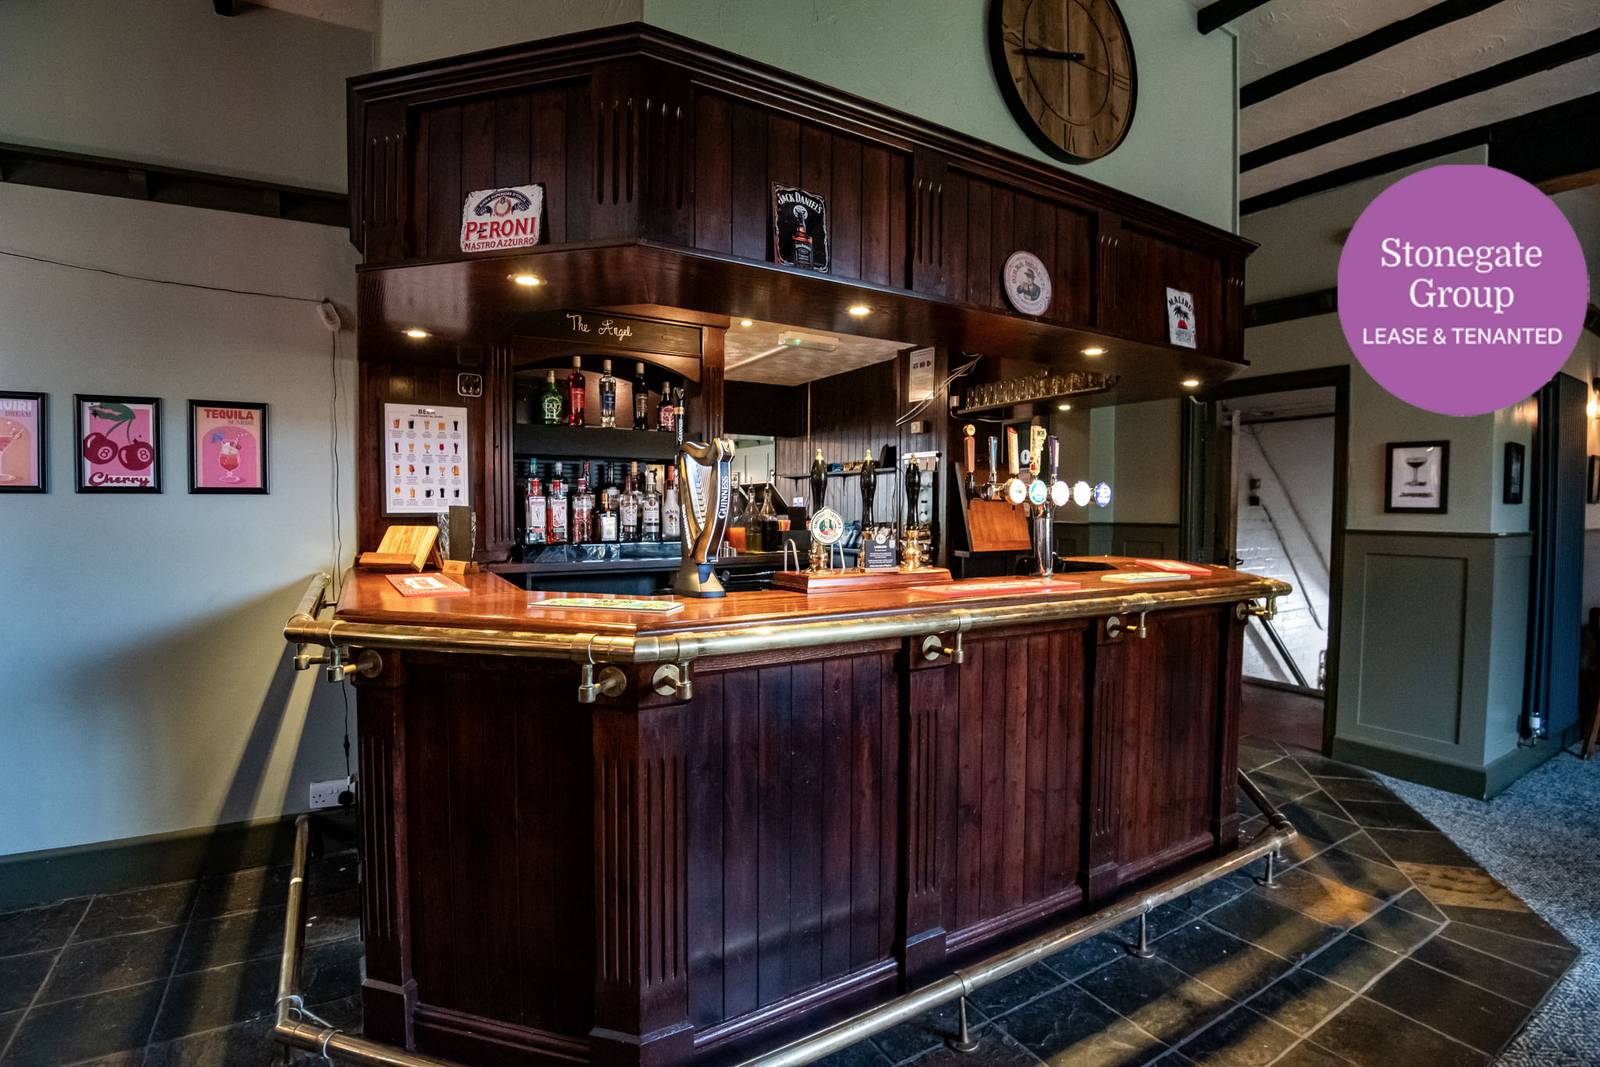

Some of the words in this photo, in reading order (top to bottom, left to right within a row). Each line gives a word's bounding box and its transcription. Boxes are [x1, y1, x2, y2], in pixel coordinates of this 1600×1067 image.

[777, 193, 795, 205] JACK
[794, 191, 822, 214] DANIEL'S
[465, 217, 536, 241] PERONI
[464, 240, 496, 250] NASTRO
[496, 237, 535, 248] AZZURRO
[566, 313, 590, 333] The
[598, 319, 633, 341] Angel
[204, 408, 254, 420] TEQUILA
[100, 448, 109, 458] 8
[139, 449, 148, 460] 8
[88, 471, 150, 487] Cherry
[718, 475, 729, 519] GUINNESS
